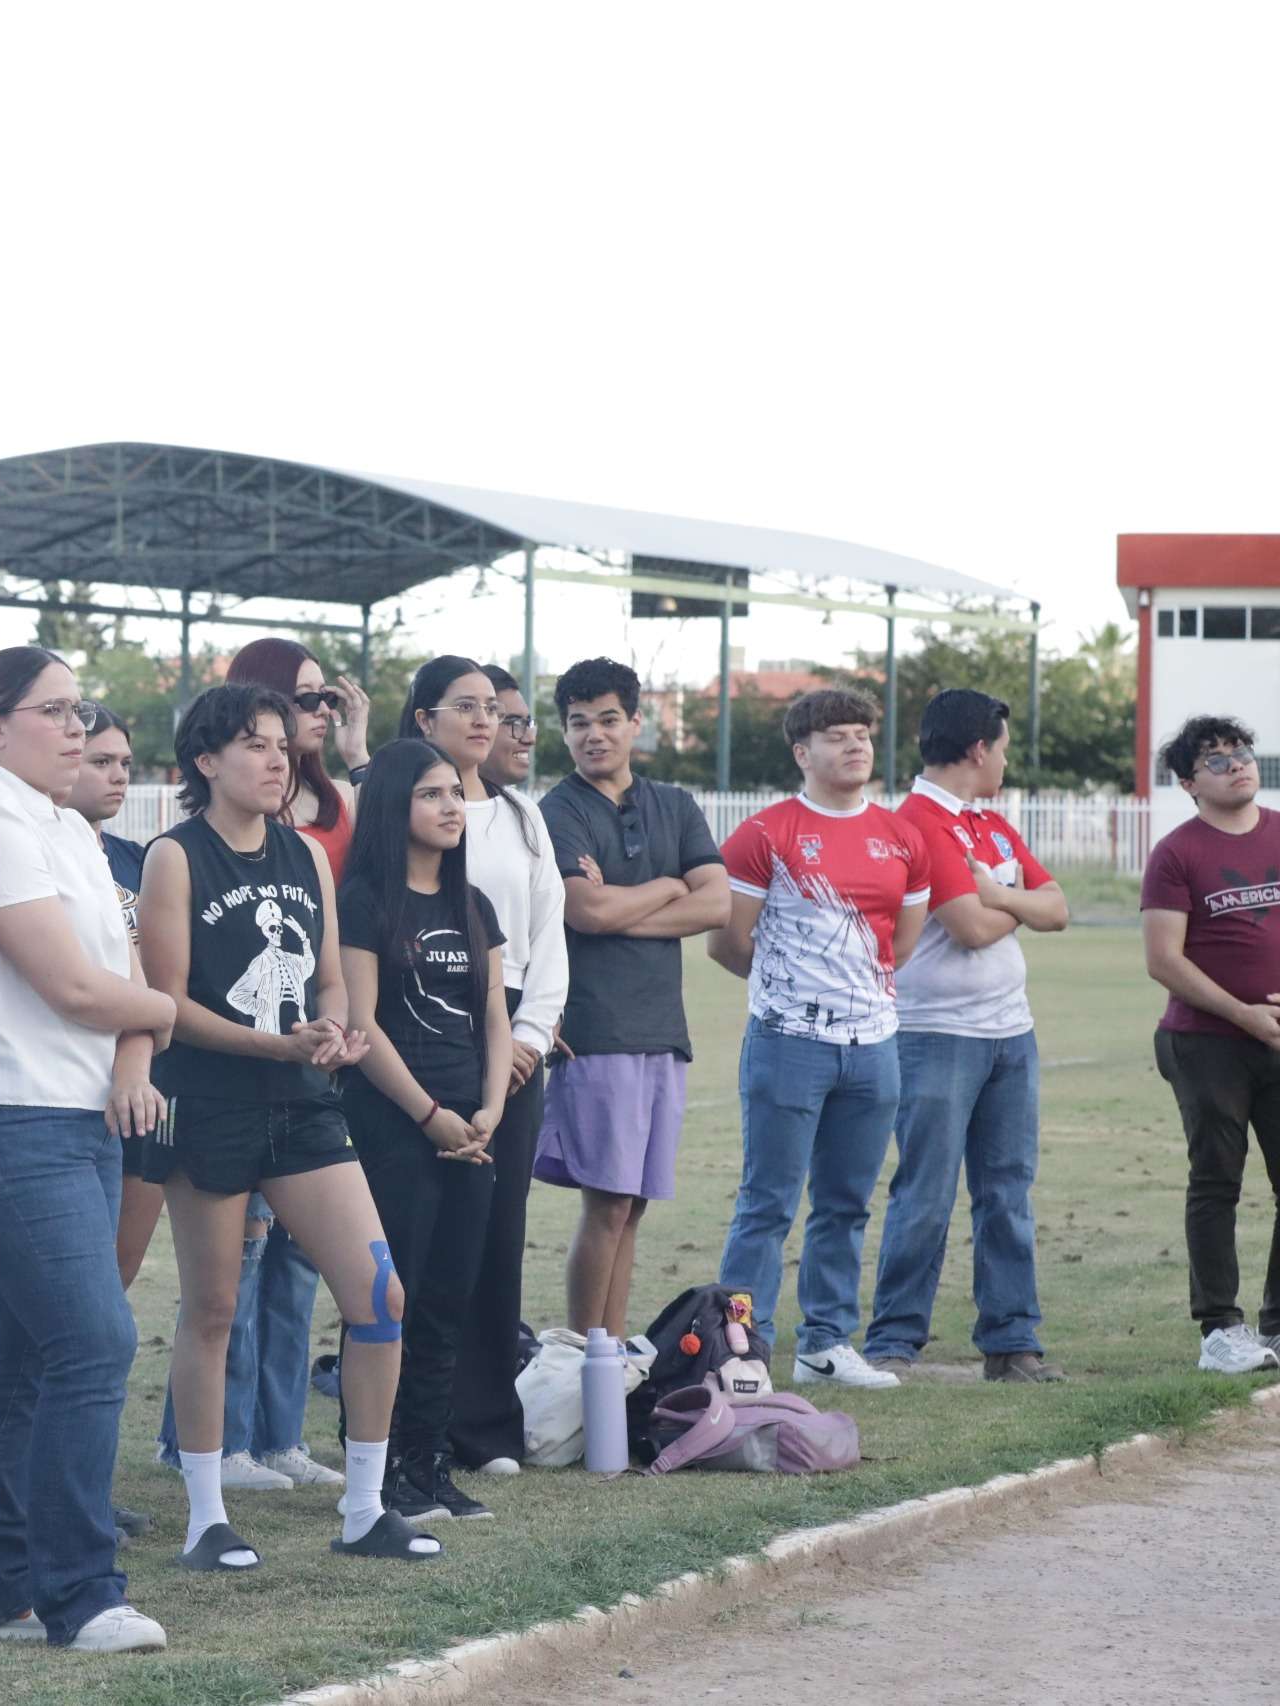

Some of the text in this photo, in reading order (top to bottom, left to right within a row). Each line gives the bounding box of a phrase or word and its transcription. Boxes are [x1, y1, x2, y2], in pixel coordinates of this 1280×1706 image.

[201, 901, 223, 925] NO
[222, 885, 257, 909] HOPE
[257, 884, 278, 898] NO
